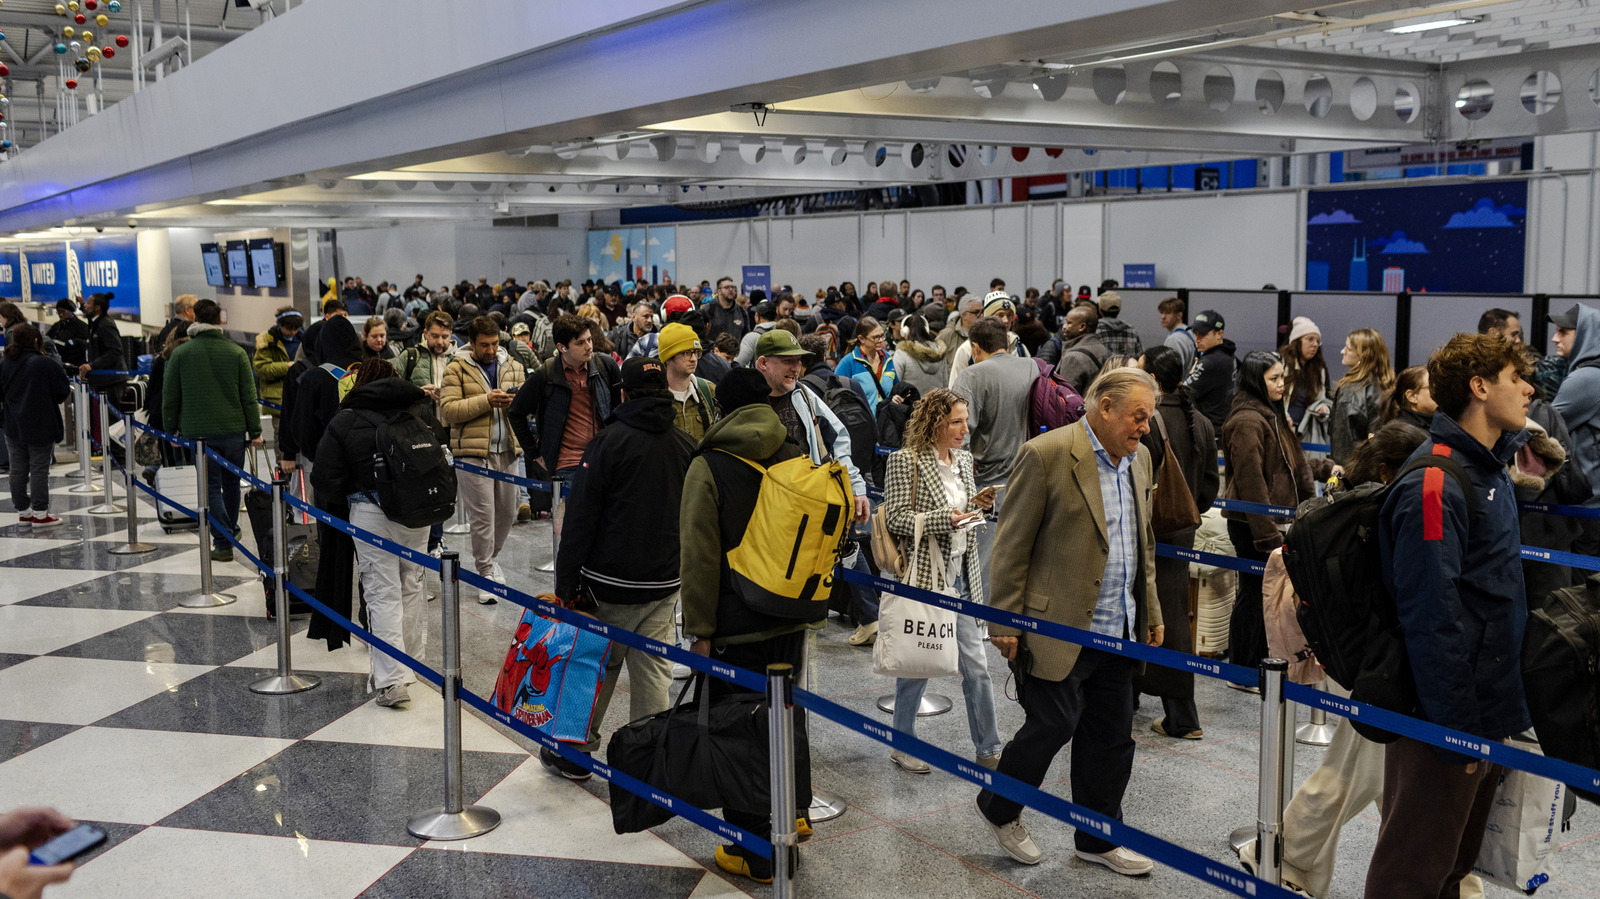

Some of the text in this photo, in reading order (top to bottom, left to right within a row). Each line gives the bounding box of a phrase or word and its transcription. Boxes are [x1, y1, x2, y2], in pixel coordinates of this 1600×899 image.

[1201, 177, 1210, 190] C
[31, 262, 56, 285] UNITED
[84, 260, 119, 288] UNITED
[1176, 550, 1195, 558] UNITED
[1521, 549, 1544, 557] UNITED
[874, 580, 890, 589] UNITED
[939, 599, 957, 608] UNITED
[588, 623, 603, 632] UNITED
[903, 619, 954, 639] BEACH
[1011, 618, 1032, 627] UNITED
[645, 643, 662, 653] UNITED
[917, 641, 943, 650] PLEASE
[1093, 638, 1116, 648] UNITED
[711, 665, 730, 676] UNITED
[1187, 660, 1213, 671] UNITED
[522, 702, 545, 713] AMAZING
[1320, 698, 1350, 712] UNITED
[513, 707, 553, 726] SPIDER-MAN
[863, 722, 886, 738] UNITED
[1445, 735, 1480, 751] UNITED
[592, 764, 607, 774] UNITED
[957, 763, 984, 780] UNITED
[651, 792, 668, 805] UNITED
[1544, 784, 1561, 843] the stuff you
[1069, 811, 1101, 830] UNITED
[718, 825, 737, 838] UNITED
[1206, 867, 1245, 889] UNITED
